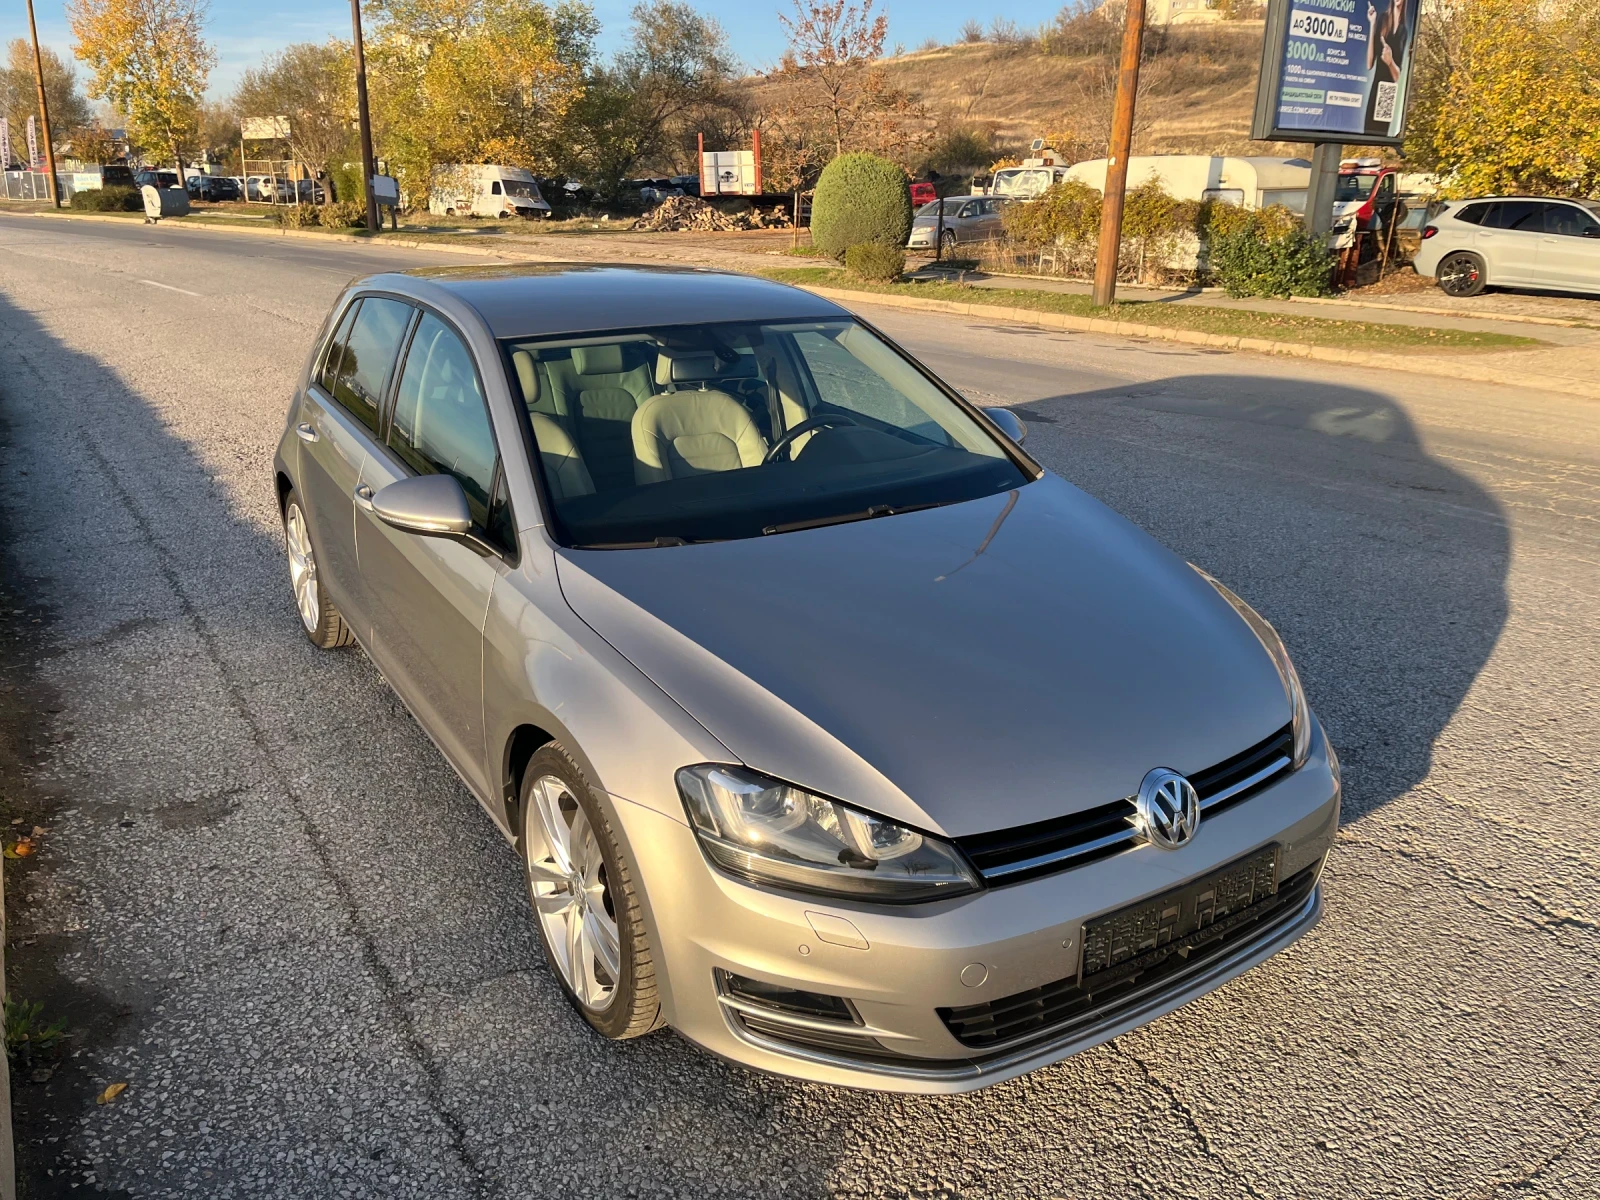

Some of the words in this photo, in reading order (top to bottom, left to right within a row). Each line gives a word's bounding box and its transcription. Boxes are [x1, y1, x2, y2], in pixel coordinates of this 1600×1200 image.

[1293, 19, 1304, 28] ДО
[1304, 16, 1334, 37] 3000
[1286, 40, 1316, 61] 3000
[1287, 64, 1301, 74] 1000
[1146, 773, 1200, 849] VW
